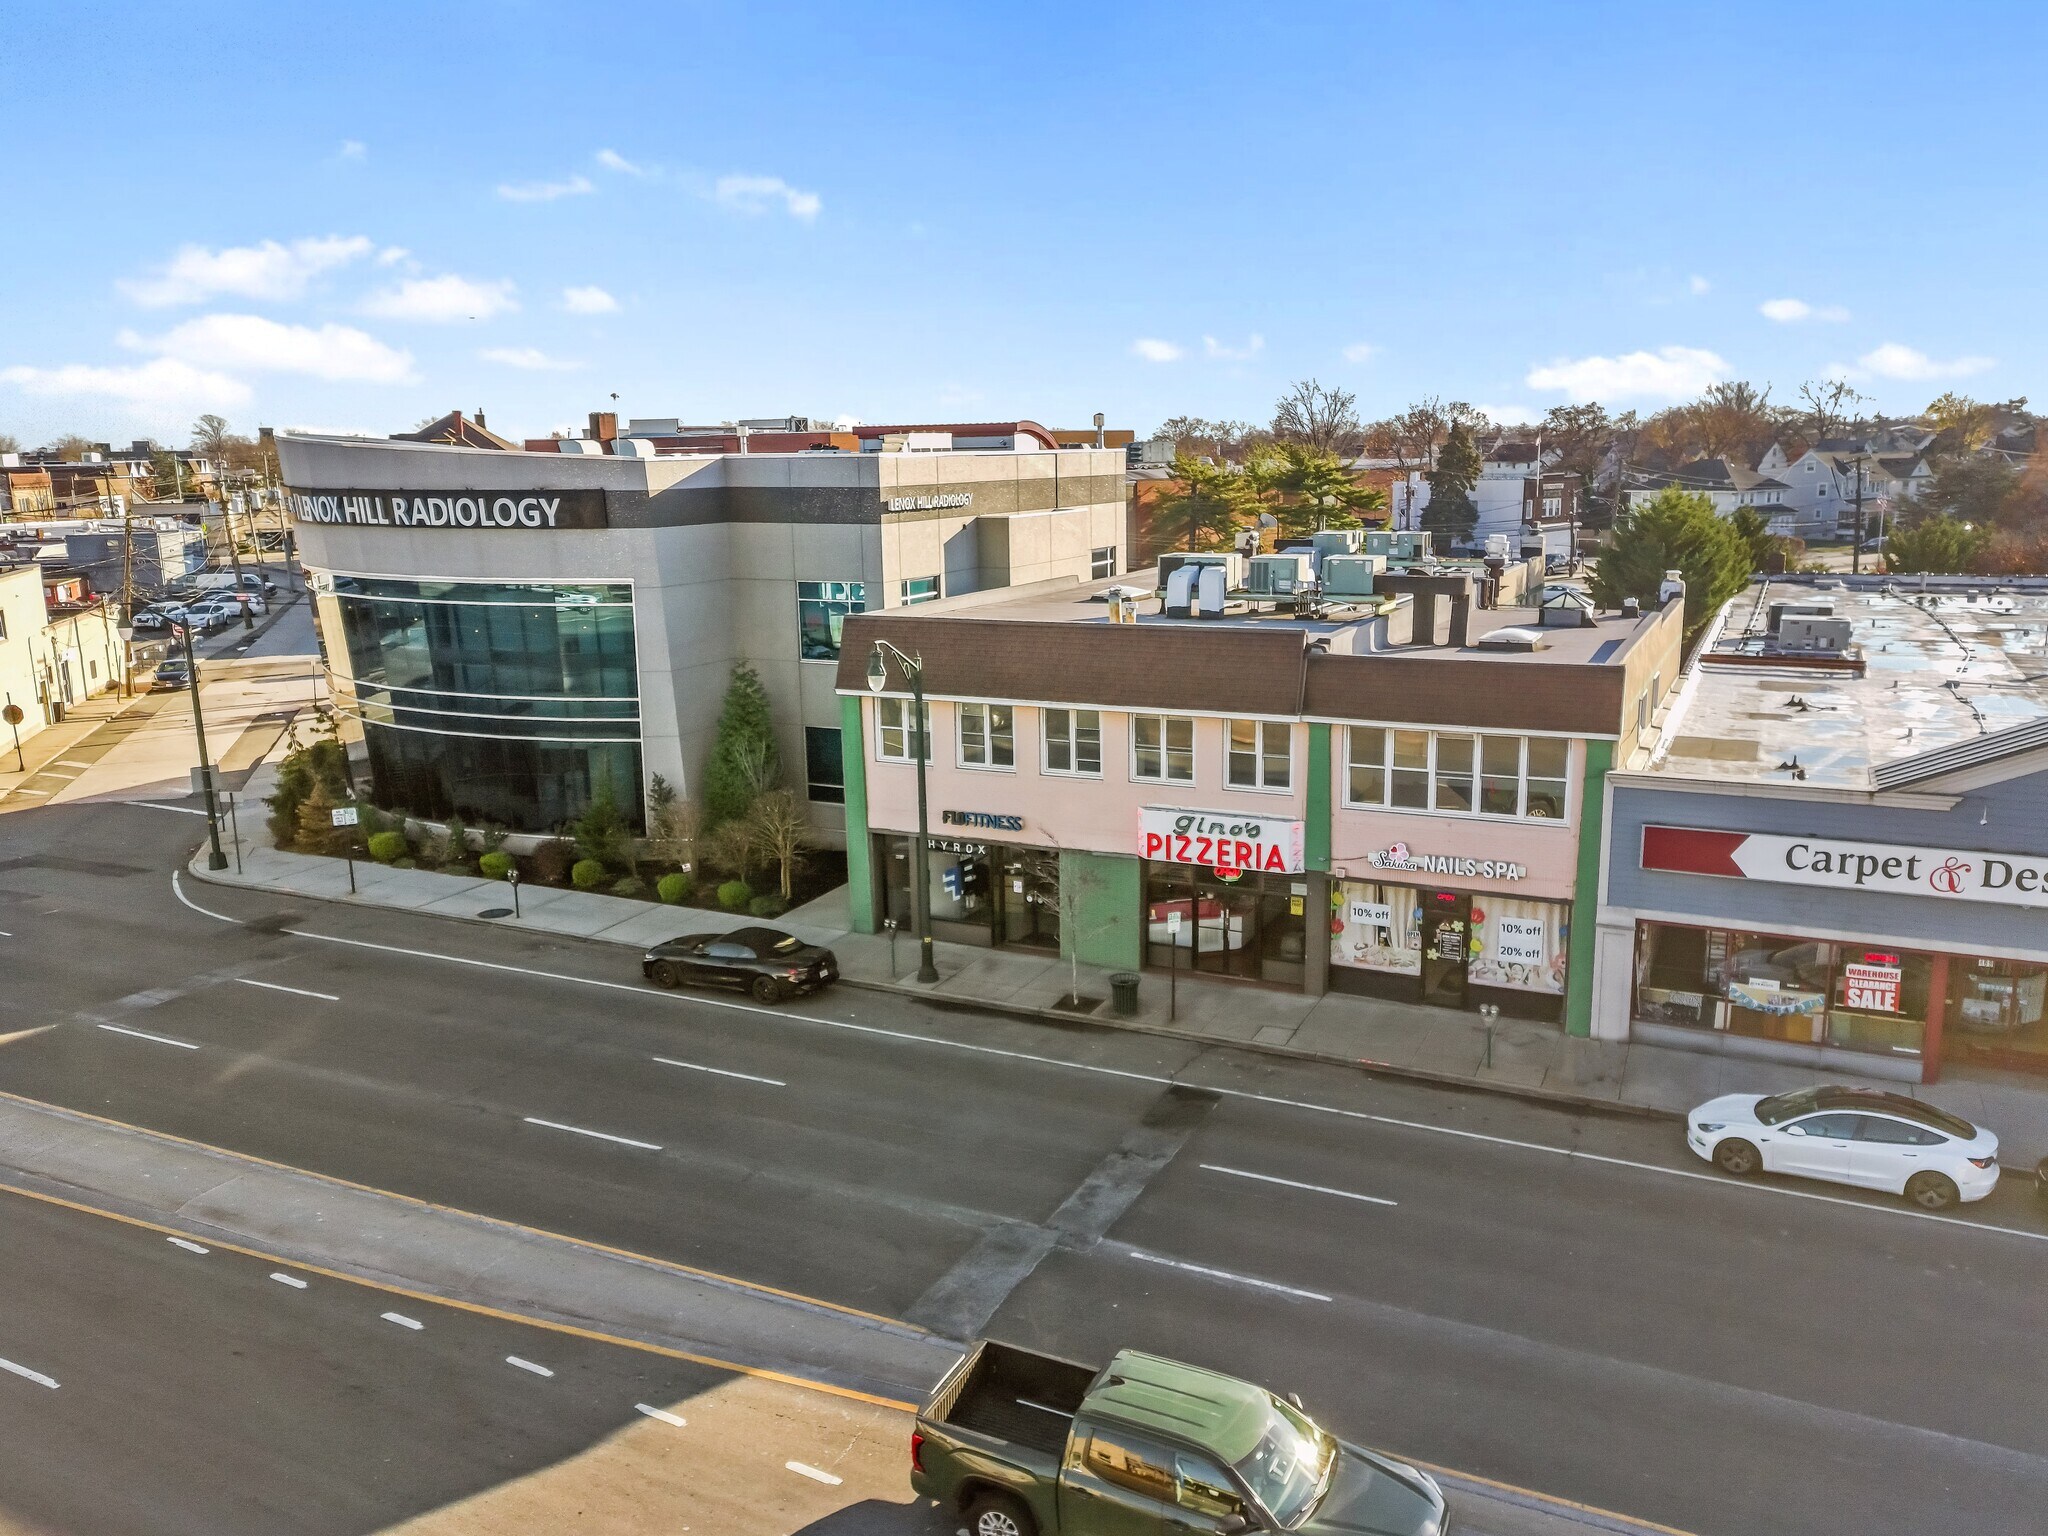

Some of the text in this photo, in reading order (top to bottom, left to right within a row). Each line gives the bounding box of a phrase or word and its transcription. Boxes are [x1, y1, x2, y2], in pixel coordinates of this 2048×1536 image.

[889, 493, 973, 511] LENOX HILL RADIOLOGY
[299, 496, 342, 523] LENOX
[343, 496, 389, 525] HILL
[392, 497, 560, 527] RADIOLOGY
[928, 840, 986, 855] HYROX
[1146, 832, 1286, 872] PIZZERIA
[1372, 851, 1519, 881] Sakura NAILS SPA
[1785, 844, 1922, 885] Carpet
[1929, 856, 1972, 894] &
[1352, 907, 1390, 920] 10% off
[1501, 923, 1541, 936] 10% off
[1500, 946, 1540, 959] 20% off
[1848, 968, 1900, 981] WAREHOUSE
[1849, 979, 1897, 991] CLEARANCE
[1847, 988, 1896, 1012] SALE
